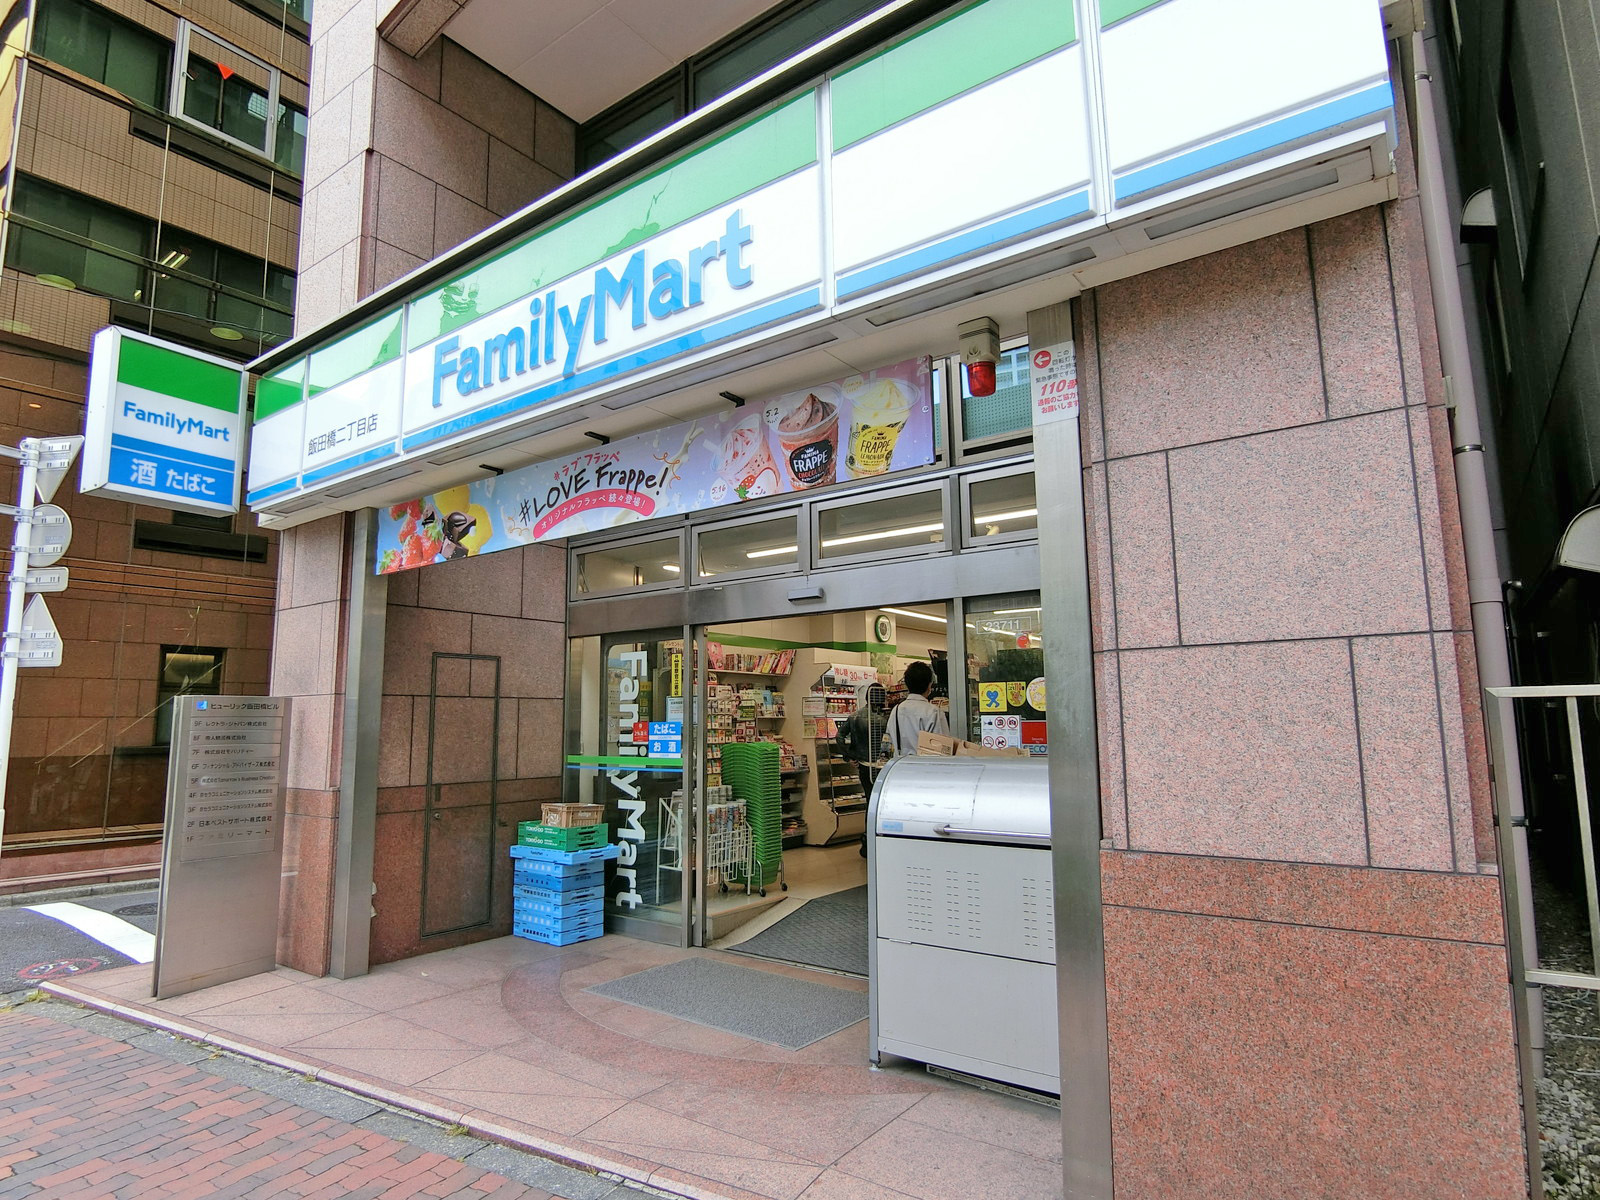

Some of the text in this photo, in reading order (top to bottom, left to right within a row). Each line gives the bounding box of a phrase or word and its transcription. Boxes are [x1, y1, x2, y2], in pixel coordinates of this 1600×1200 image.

[432, 208, 754, 408] FamilyMart
[123, 400, 230, 442] FamilyMart
[308, 413, 378, 456] 飯田橋二丁目店
[793, 450, 828, 473] FRAPPE
[860, 439, 892, 453] FRAPPE
[130, 458, 216, 496] 酒 たばこ
[518, 462, 669, 527] #LOVE Frappe!
[986, 619, 1020, 631] 23711
[653, 723, 676, 734] たばこ
